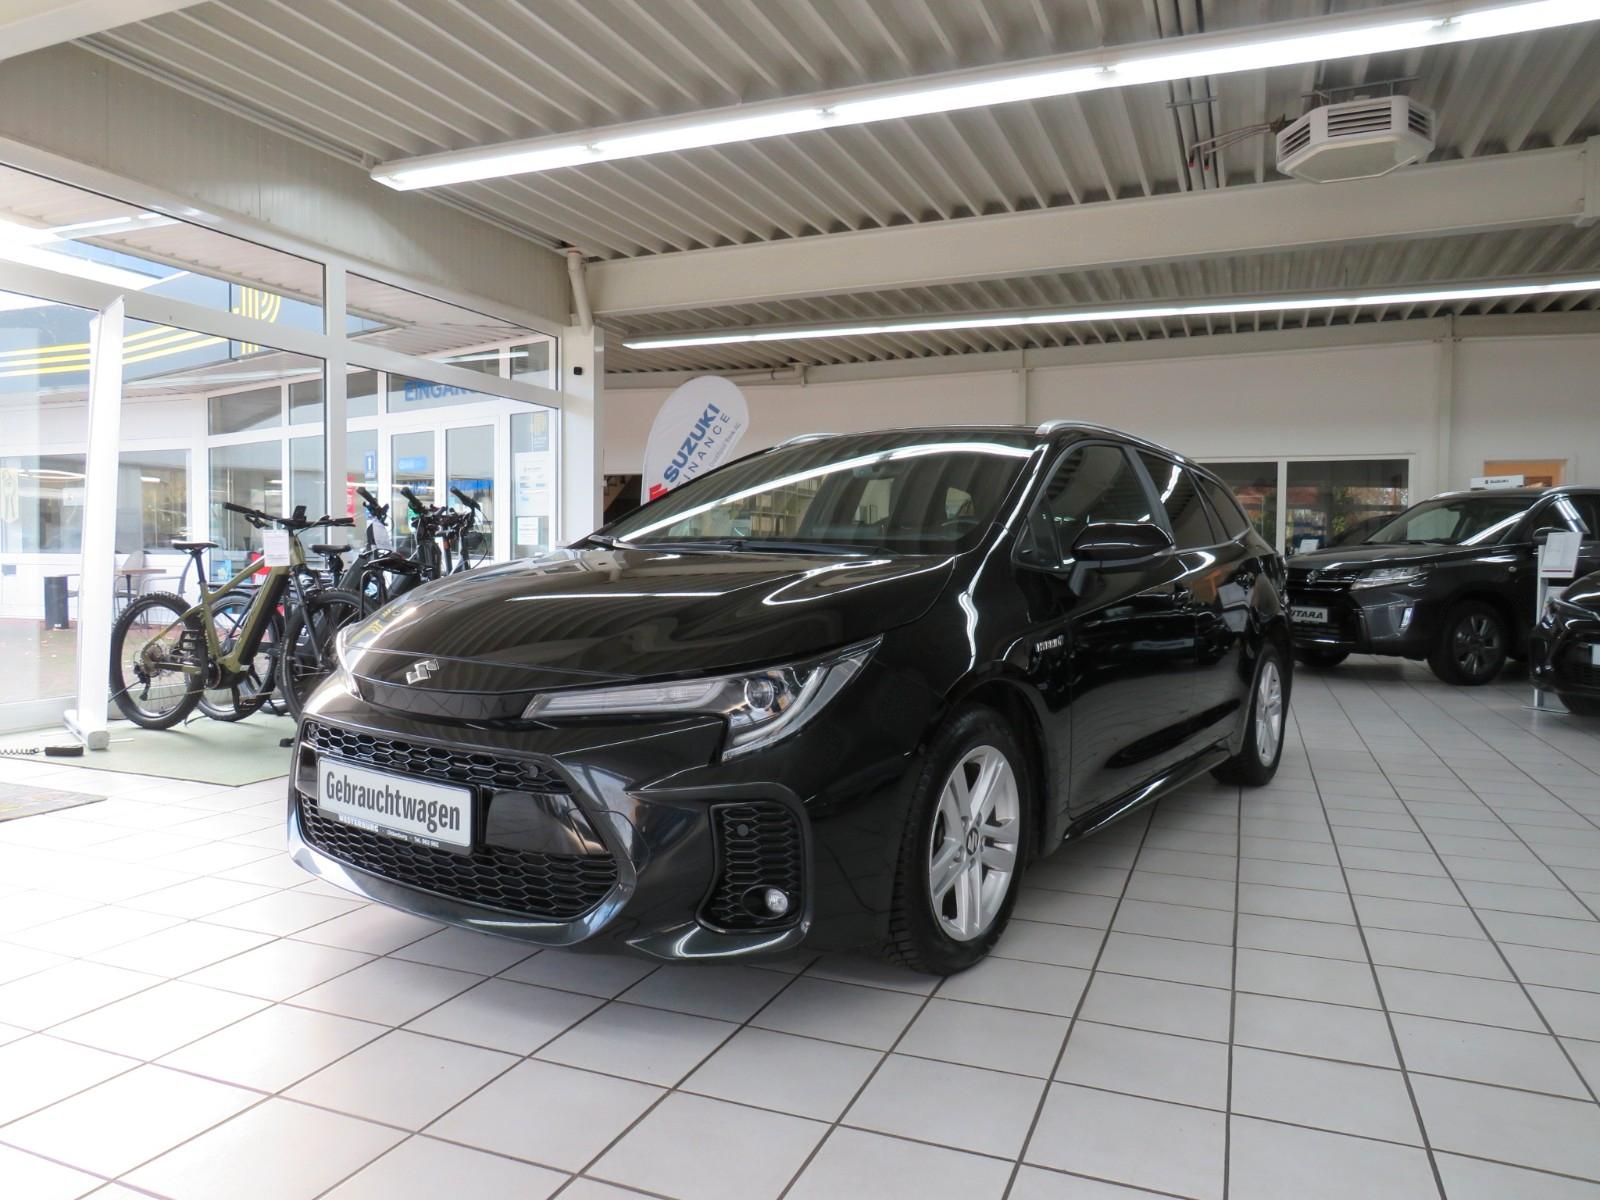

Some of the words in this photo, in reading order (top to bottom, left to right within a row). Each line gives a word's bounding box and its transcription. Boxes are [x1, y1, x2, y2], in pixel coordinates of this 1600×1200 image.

[663, 403, 720, 483] SUZUKI
[677, 412, 730, 486] INANCE
[326, 771, 460, 833] Gebrauchtwagen
